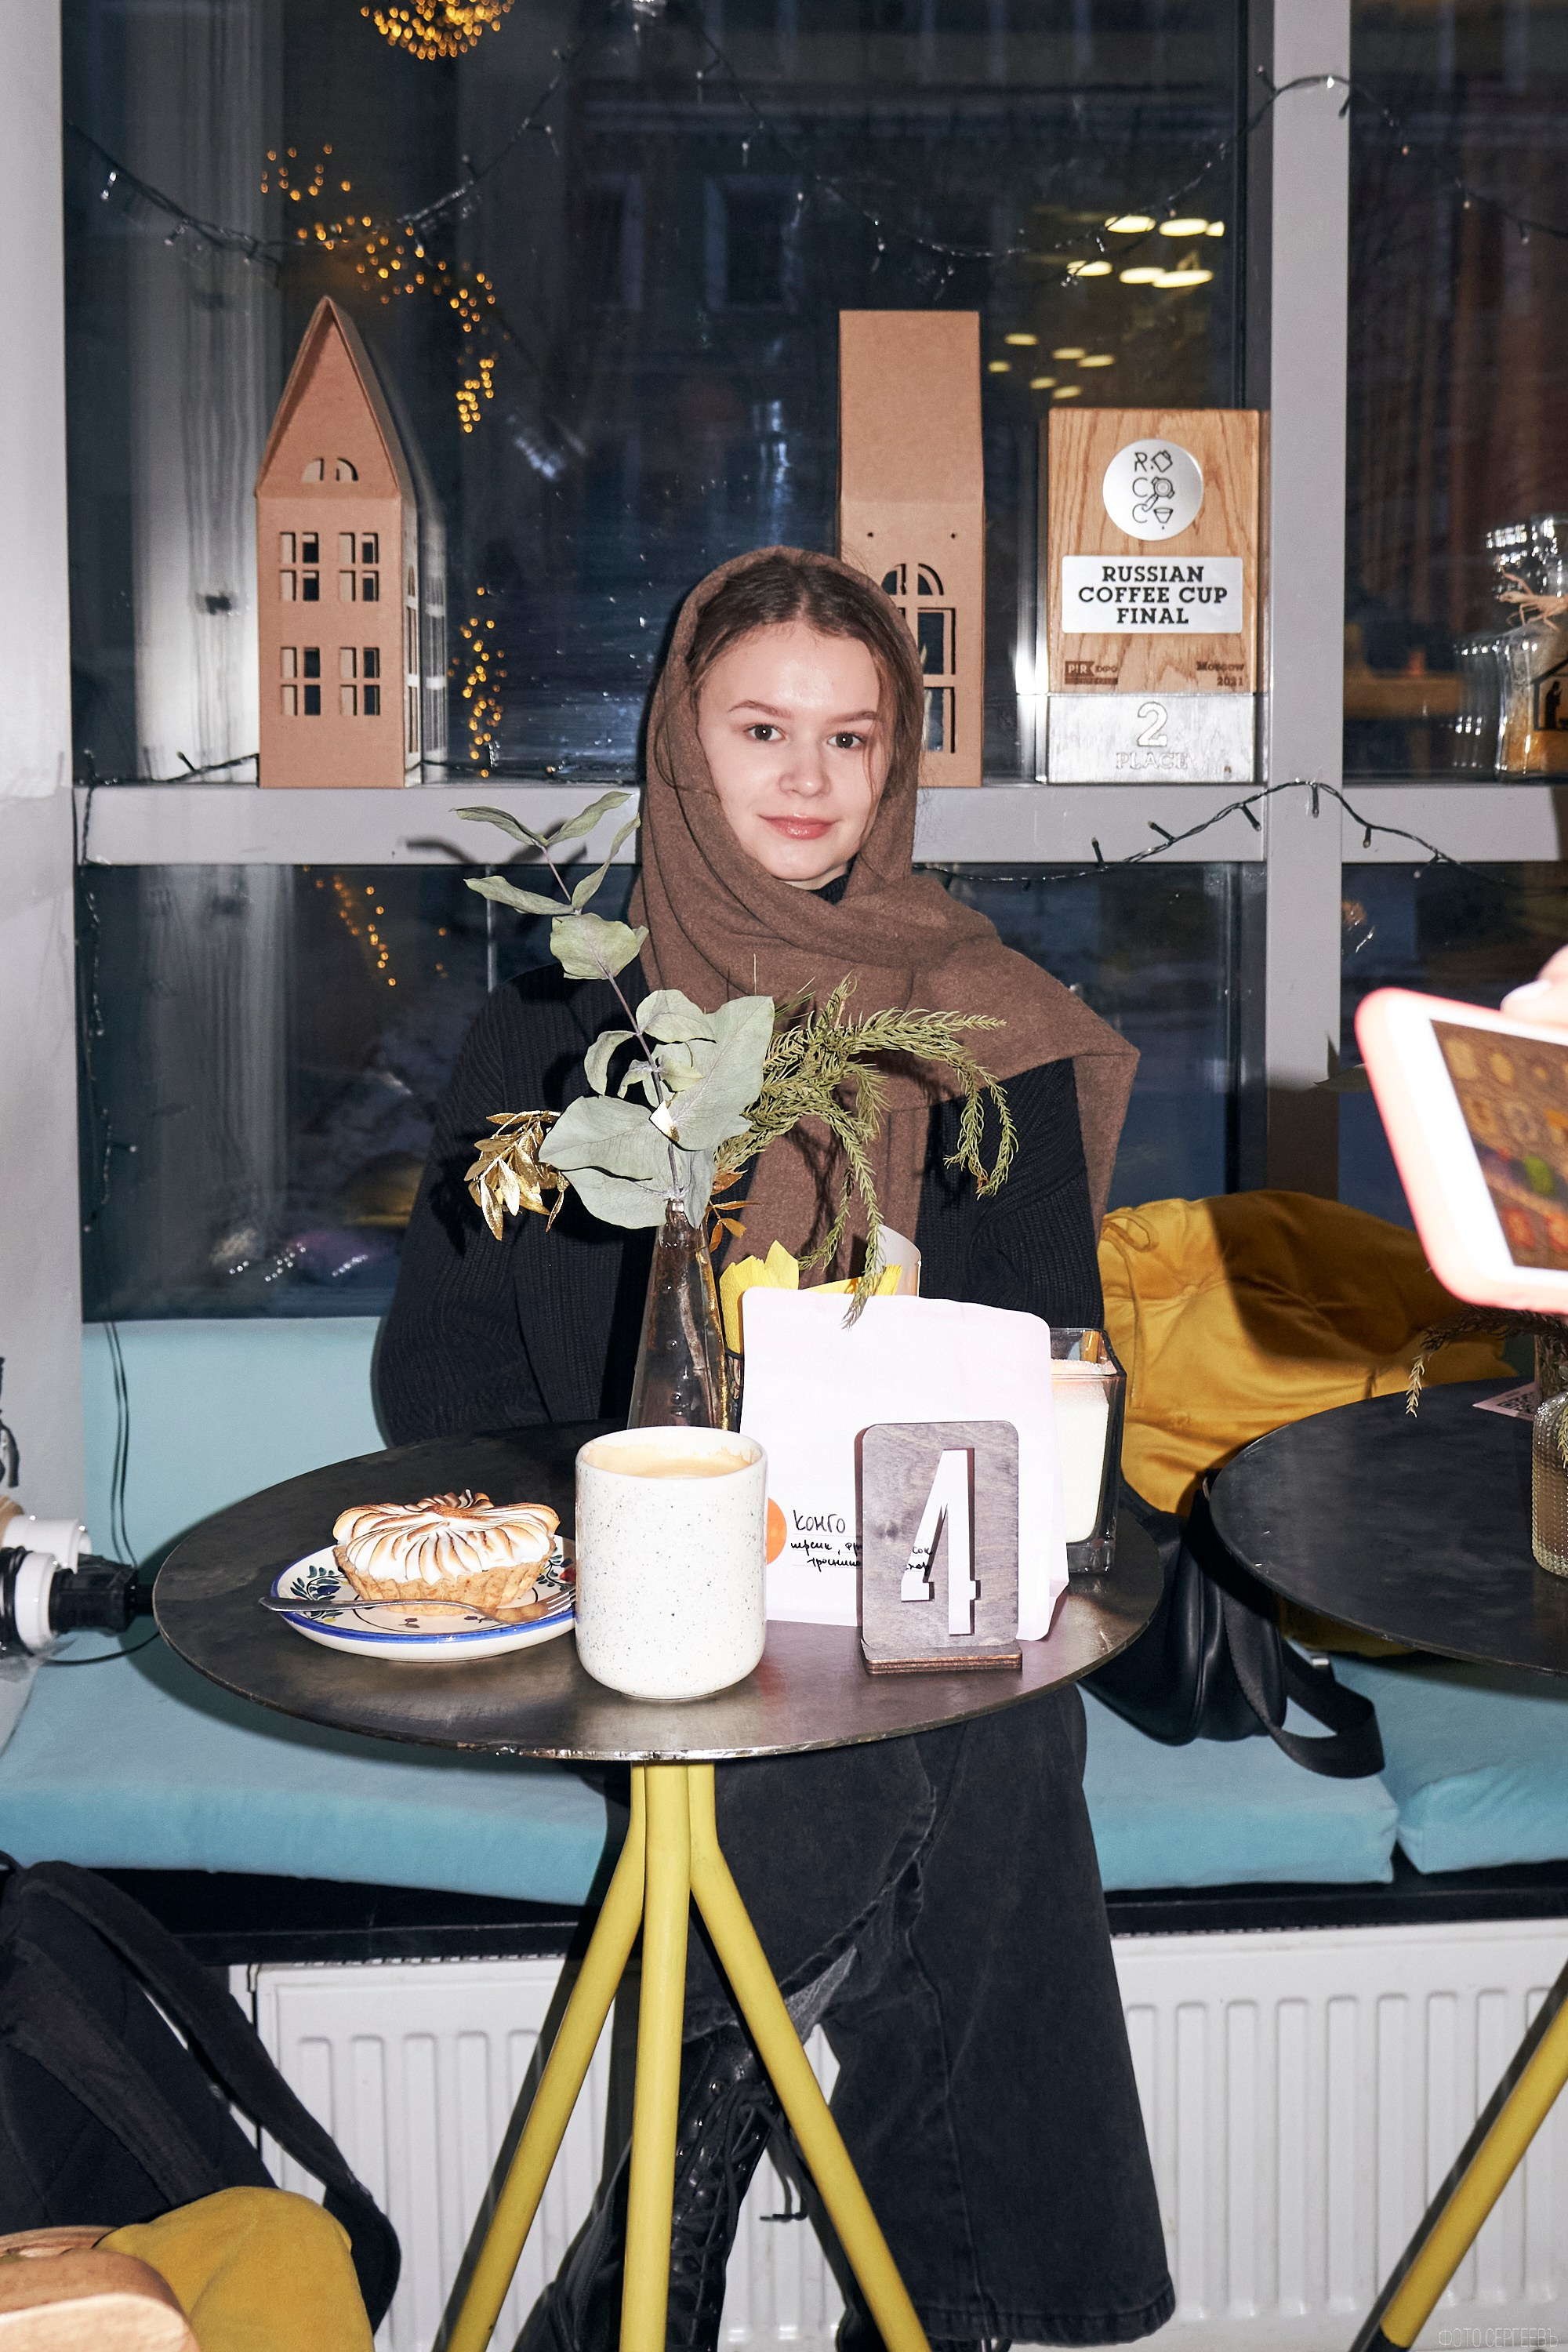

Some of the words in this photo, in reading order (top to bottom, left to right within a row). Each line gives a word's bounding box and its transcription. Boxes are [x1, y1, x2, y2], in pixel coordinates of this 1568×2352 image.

[1102, 565, 1204, 583] RUSSIAN
[1078, 586, 1171, 603] COFFEE
[1178, 586, 1228, 604] CUP
[1116, 607, 1189, 624] FINAL
[1068, 663, 1087, 674] PIR
[1196, 661, 1245, 672] Moscow
[1217, 676, 1243, 687] 2021
[1136, 700, 1168, 748] 2
[1116, 751, 1189, 770] PLACE
[901, 1447, 981, 1635] 4
